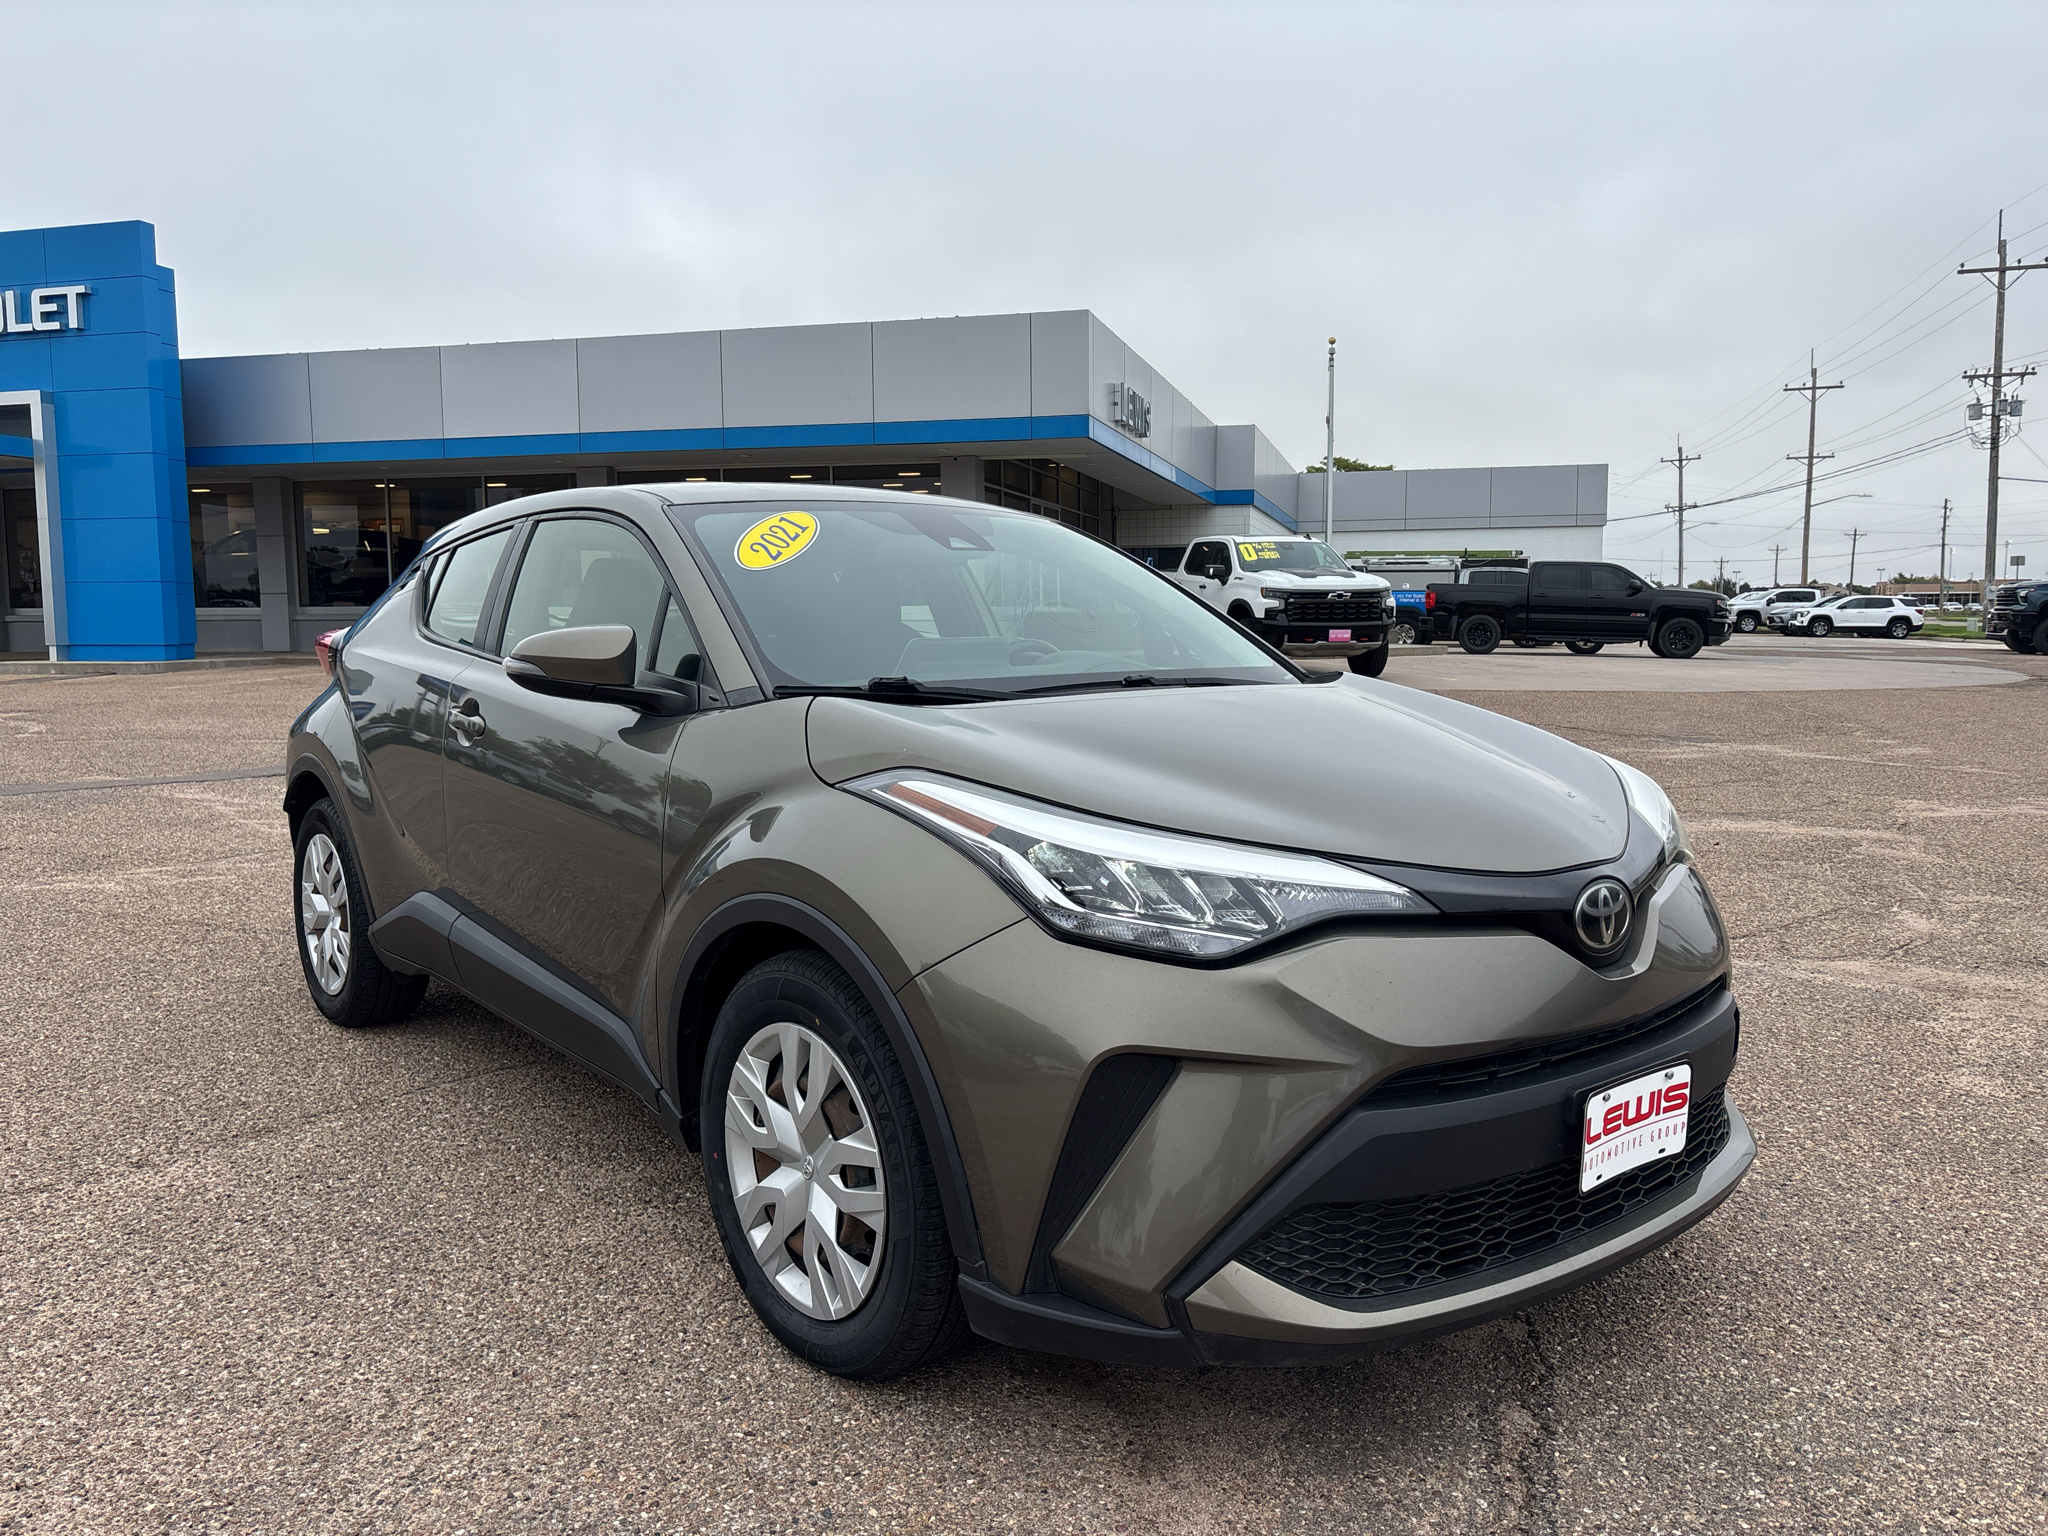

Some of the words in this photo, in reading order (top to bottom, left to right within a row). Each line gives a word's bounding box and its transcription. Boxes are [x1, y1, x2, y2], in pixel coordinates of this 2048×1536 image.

[0, 285, 90, 333] LET
[749, 516, 810, 561] 2021
[1585, 1081, 1689, 1146] LEWIS
[1583, 1134, 1643, 1174] AUTOMOTIVE
[1650, 1121, 1686, 1143] GROUP
